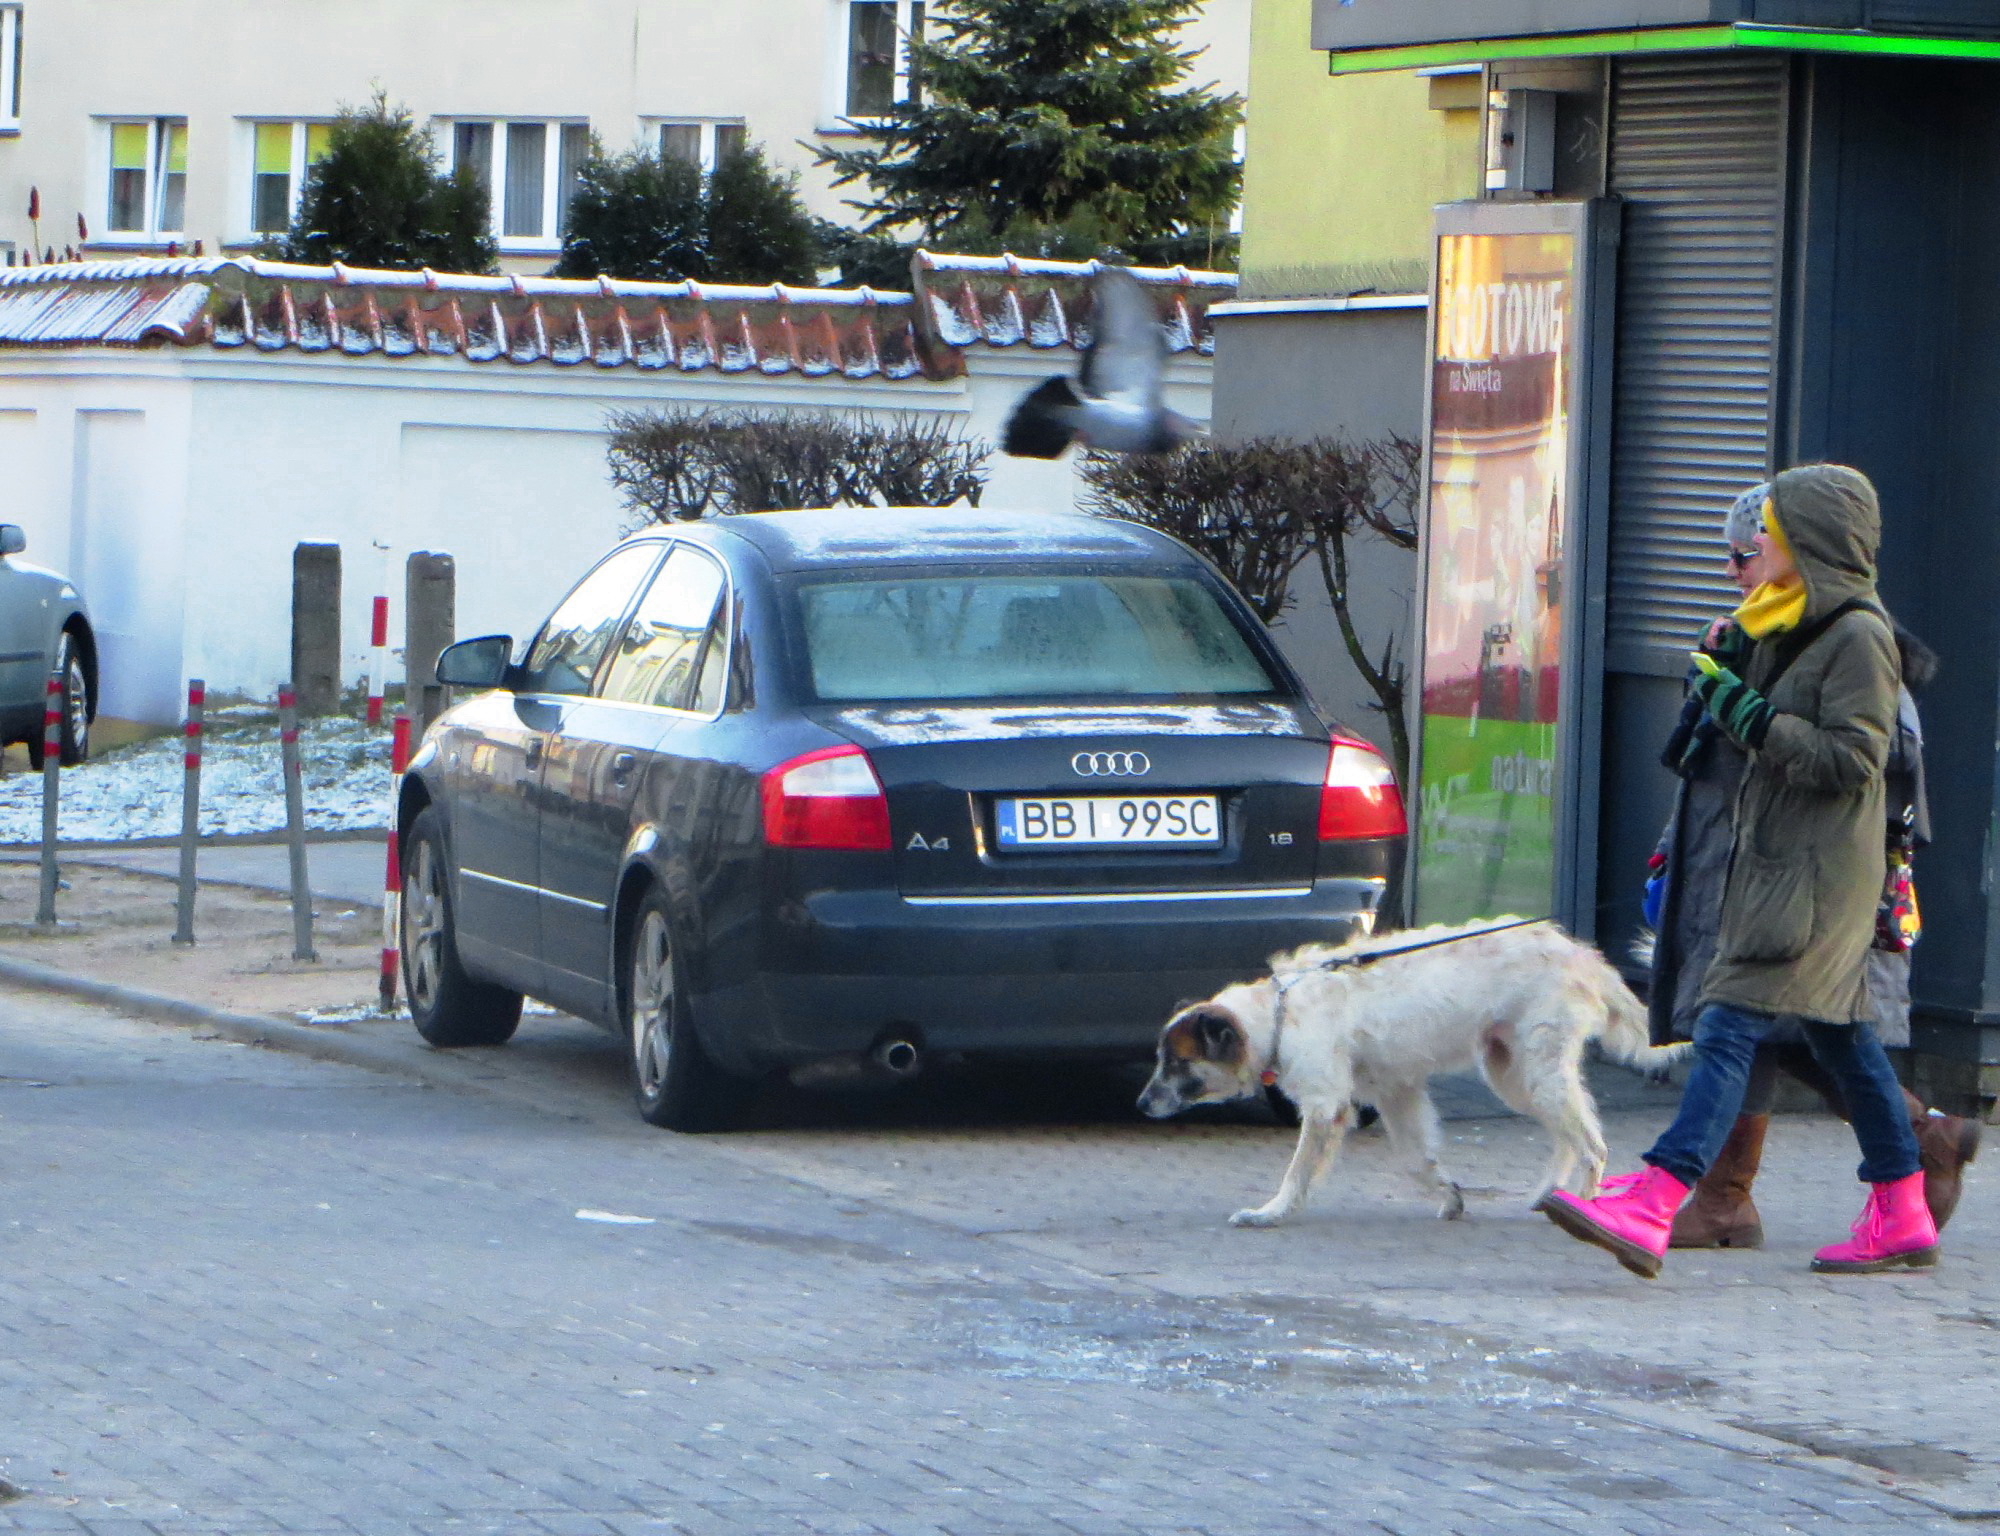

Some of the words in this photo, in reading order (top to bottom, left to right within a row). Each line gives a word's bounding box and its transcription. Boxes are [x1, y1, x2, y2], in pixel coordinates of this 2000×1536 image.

[1023, 801, 1095, 839] BBI
[1119, 800, 1212, 838] 99SC
[1002, 826, 1016, 837] PL
[906, 832, 950, 851] A4
